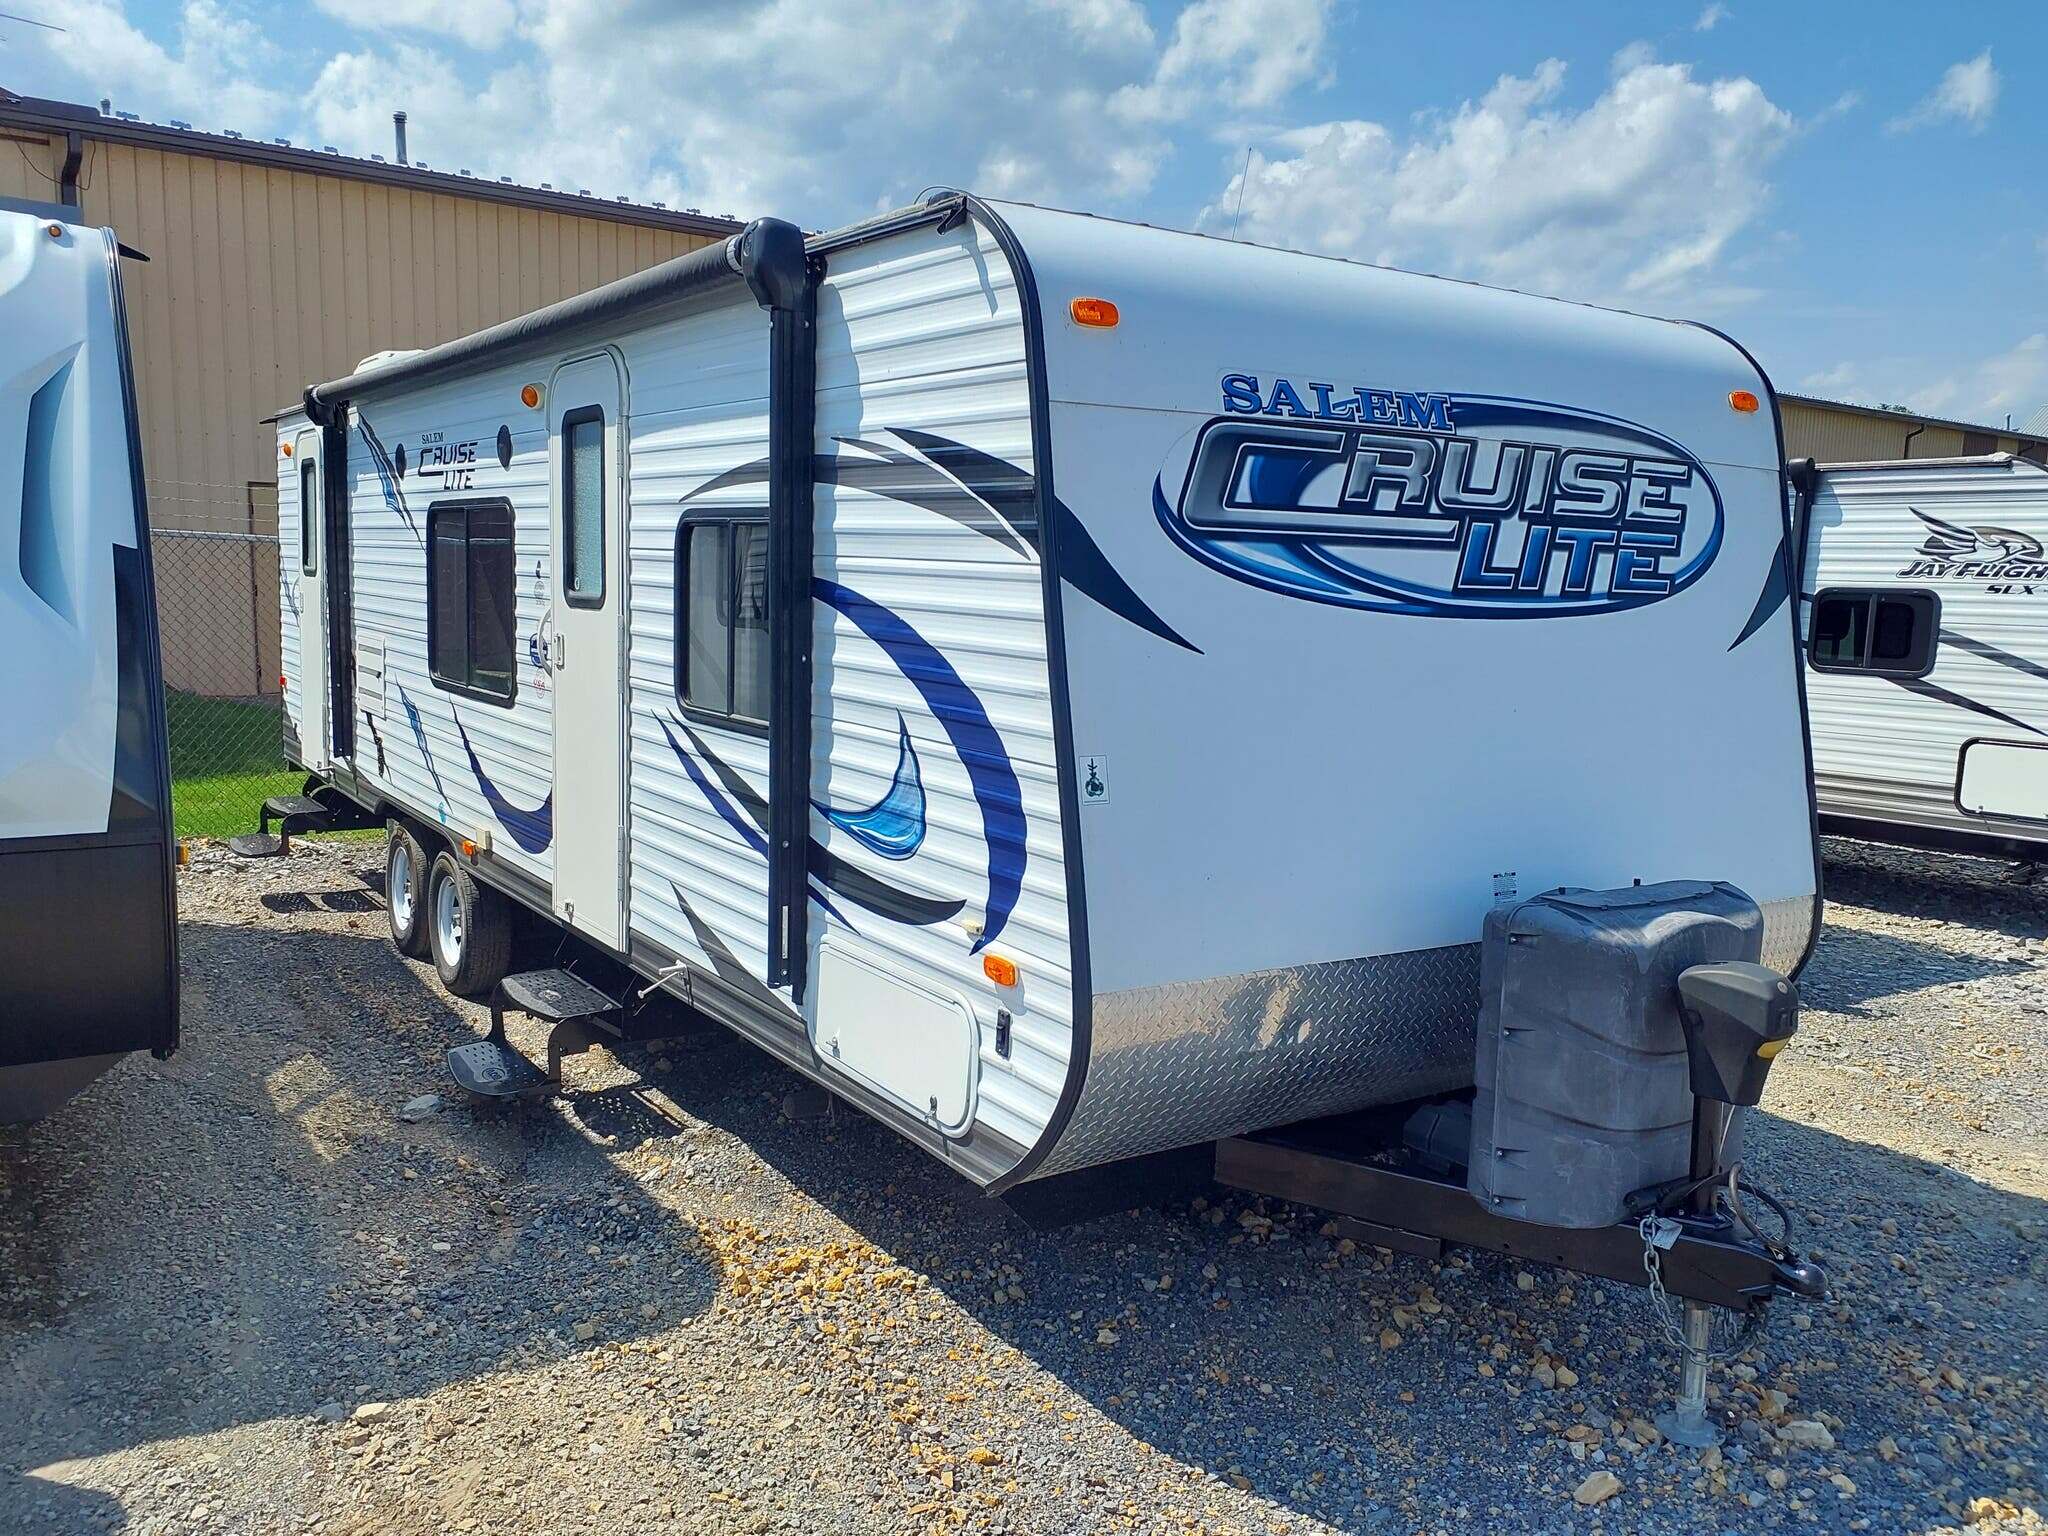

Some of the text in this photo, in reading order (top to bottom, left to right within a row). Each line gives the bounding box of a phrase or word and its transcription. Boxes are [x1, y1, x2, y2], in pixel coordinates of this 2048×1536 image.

[1220, 373, 1456, 435] SALEM
[421, 431, 444, 445] SALEM
[417, 442, 479, 477] CRUISE
[443, 468, 476, 491] LITE
[1179, 417, 1691, 546] CRUISE
[1454, 520, 1682, 597] LITE
[1897, 560, 1956, 578] JAY
[1984, 584, 2039, 595] SLX
